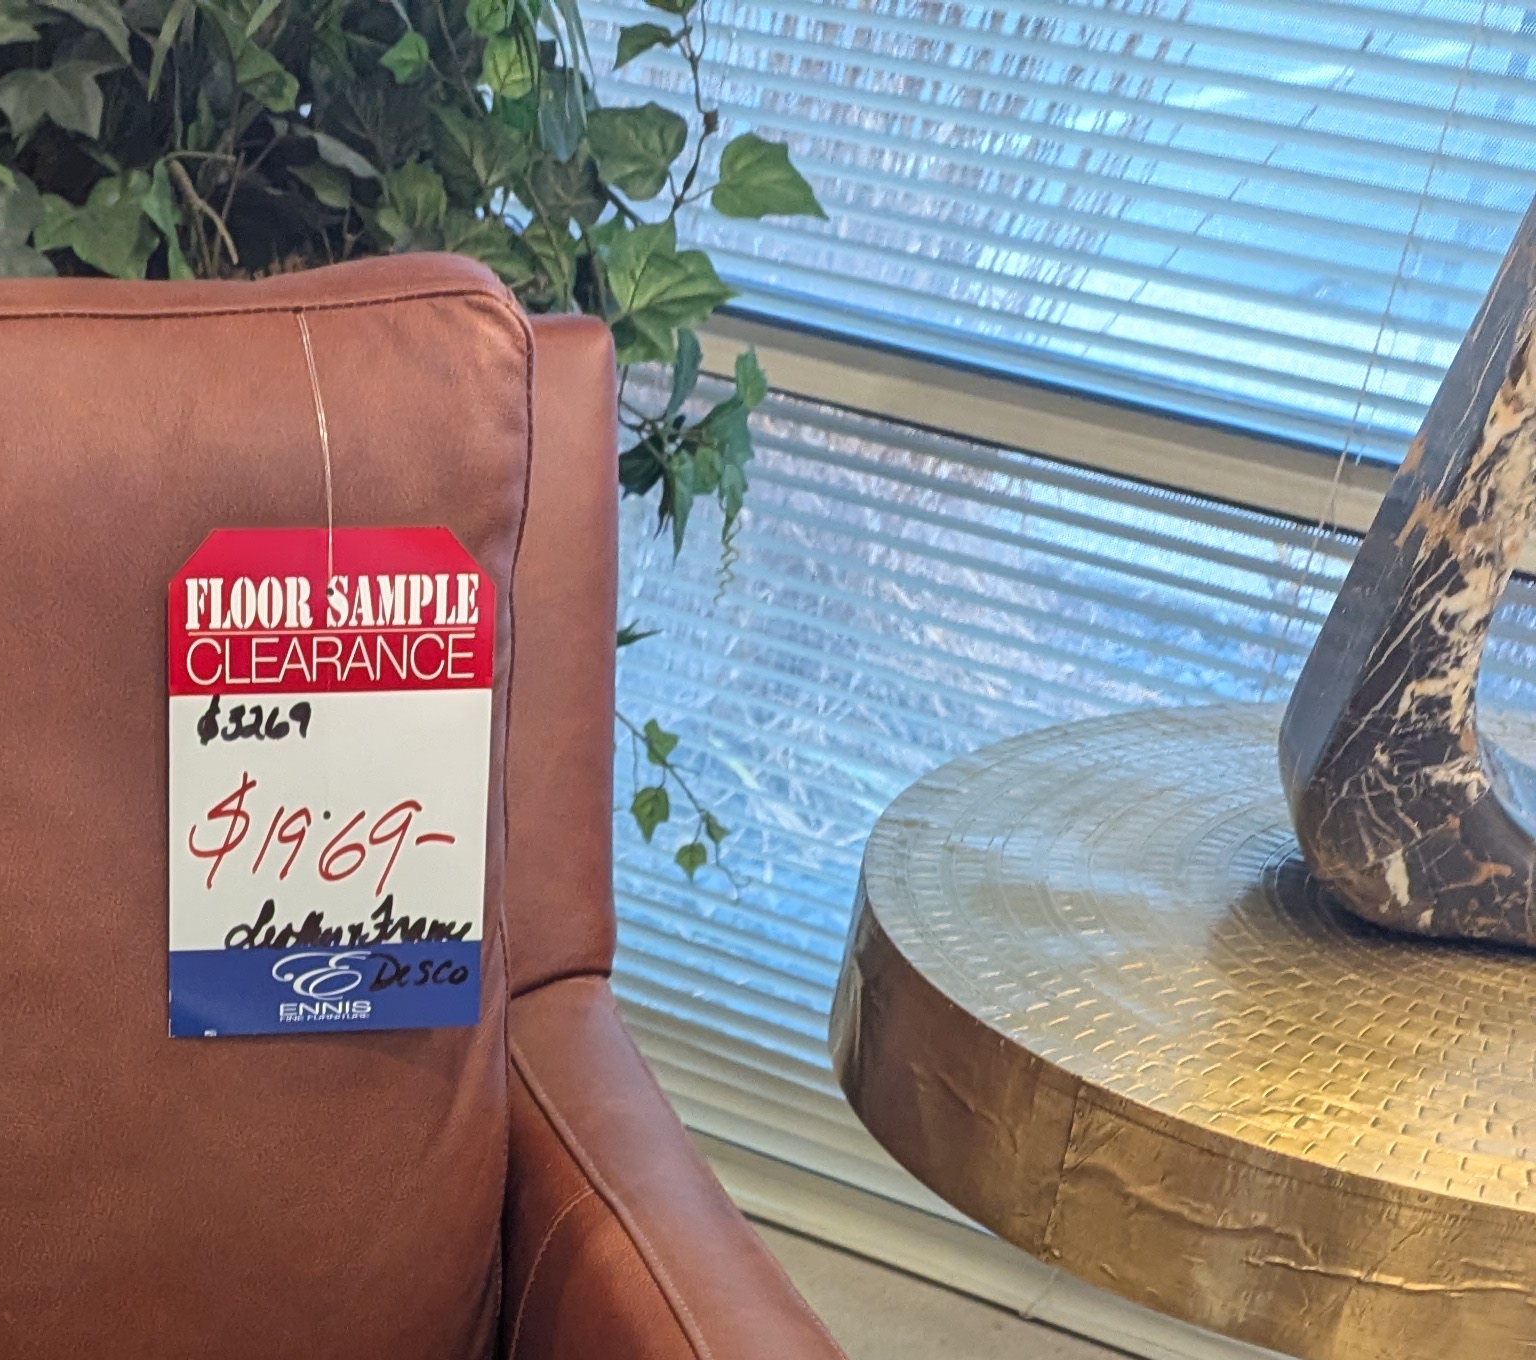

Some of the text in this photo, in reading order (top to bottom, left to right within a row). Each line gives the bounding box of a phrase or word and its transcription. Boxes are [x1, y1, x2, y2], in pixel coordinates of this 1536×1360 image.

[185, 572, 480, 631] FLOOR SAMPLE
[186, 632, 476, 686] CLEARANCE
[197, 694, 312, 746] $3269
[279, 999, 372, 1016] ENNIS
